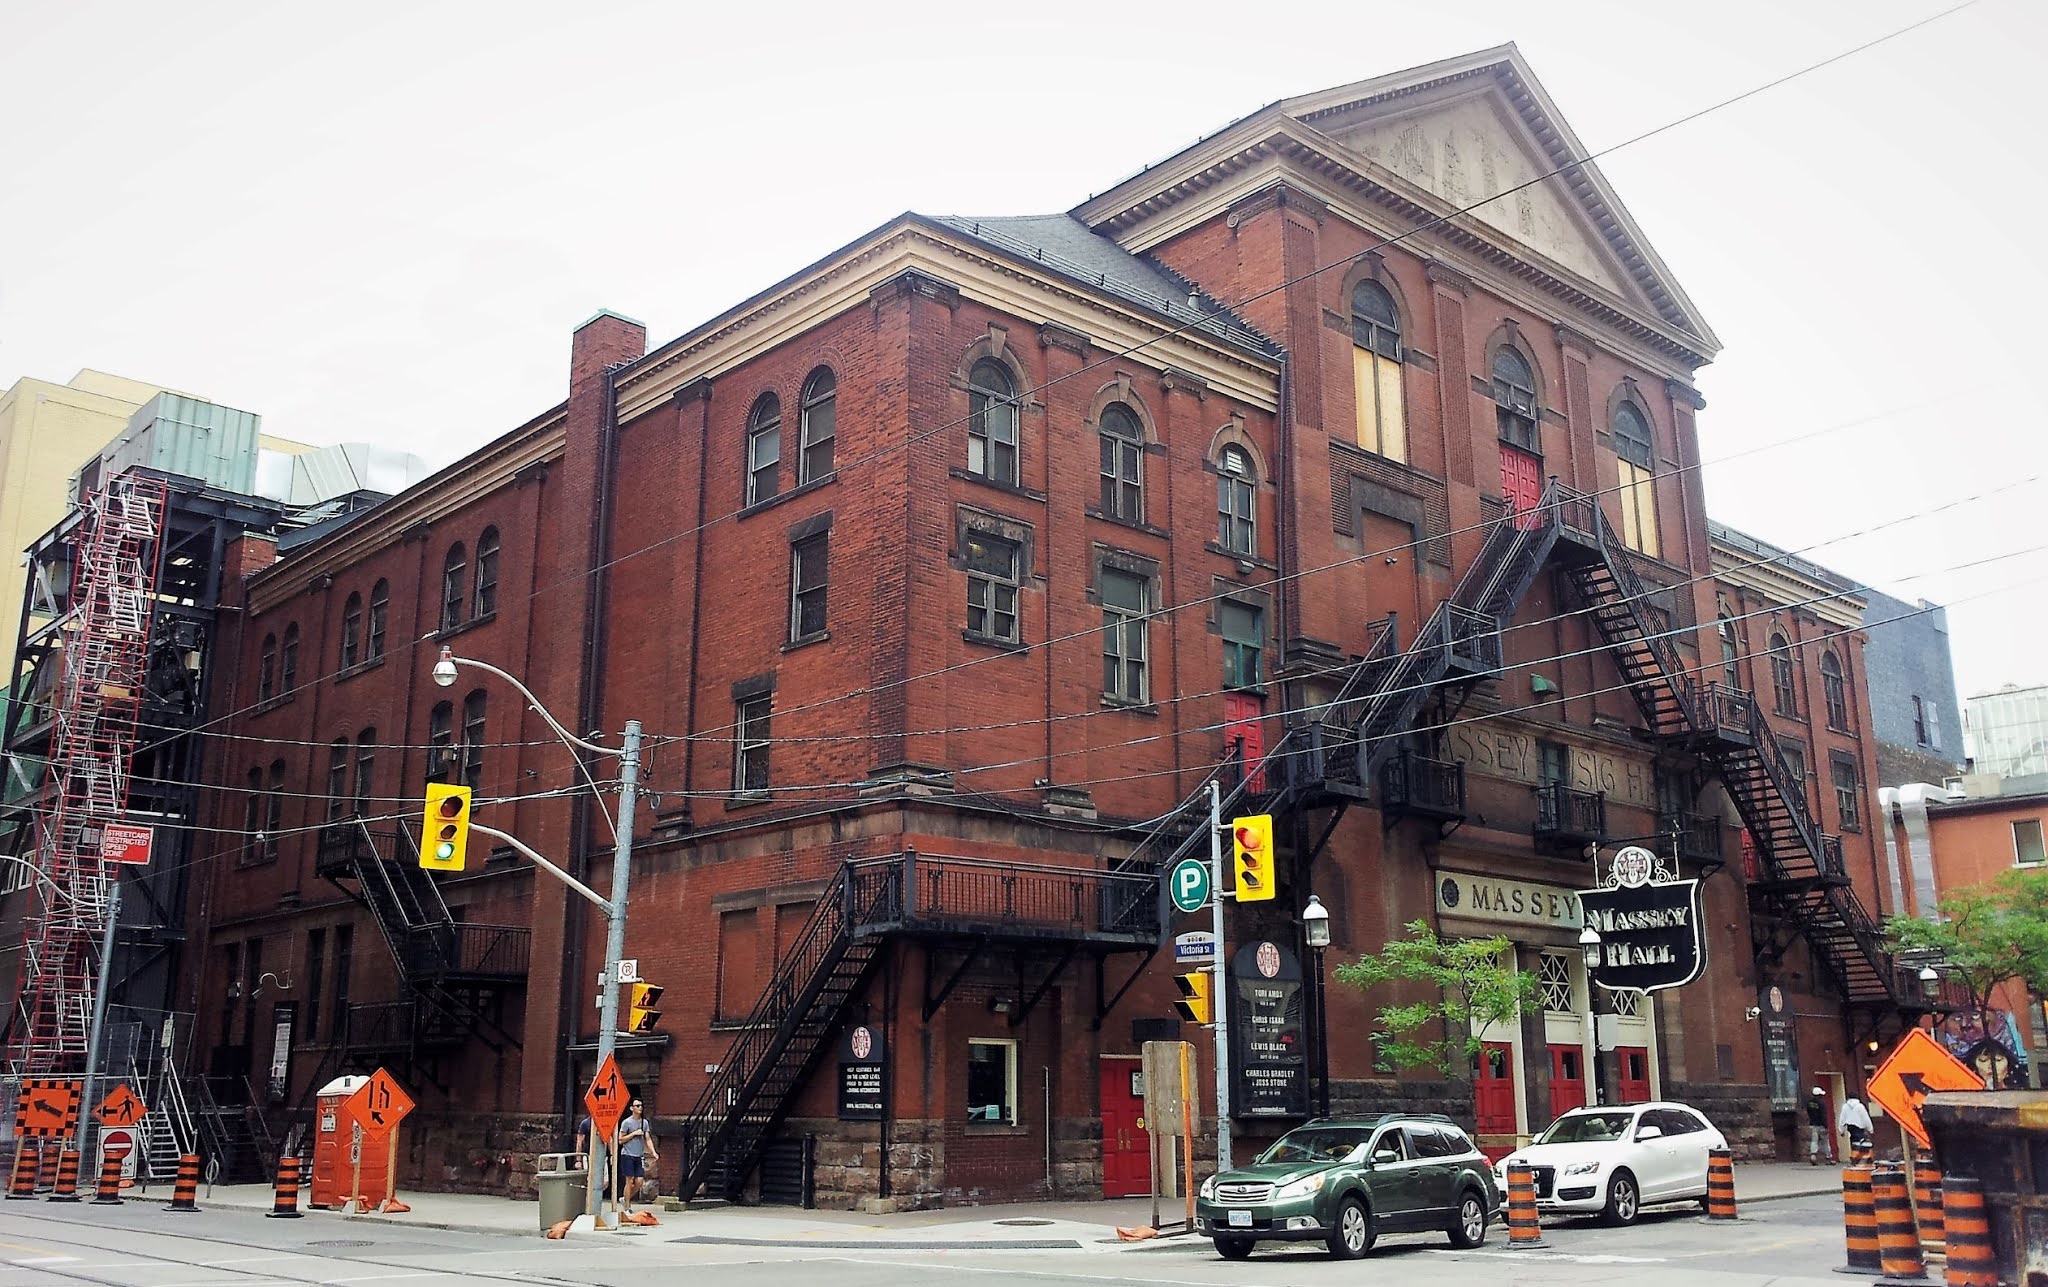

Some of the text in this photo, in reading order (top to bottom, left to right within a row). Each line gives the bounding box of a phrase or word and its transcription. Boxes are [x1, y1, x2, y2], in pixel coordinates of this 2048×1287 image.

[106, 829, 150, 840] STREETCARS
[106, 837, 147, 846] RESTRICTED
[105, 843, 128, 851] SPEED
[104, 850, 123, 858] ZONE
[1180, 868, 1202, 898] P
[1472, 884, 1577, 920] MASSEY
[1584, 907, 1688, 932] MASSEY
[1180, 943, 1204, 955] Victoria
[1604, 942, 1676, 967] HALL
[1255, 989, 1283, 998] TORI AMOS
[1252, 1015, 1285, 1024] CHRIS ISAAK
[1251, 1042, 1286, 1051] LEWIS BLACK
[1245, 1069, 1295, 1078] CHARLES BRADLEY
[1270, 1079, 1287, 1087] STONE
